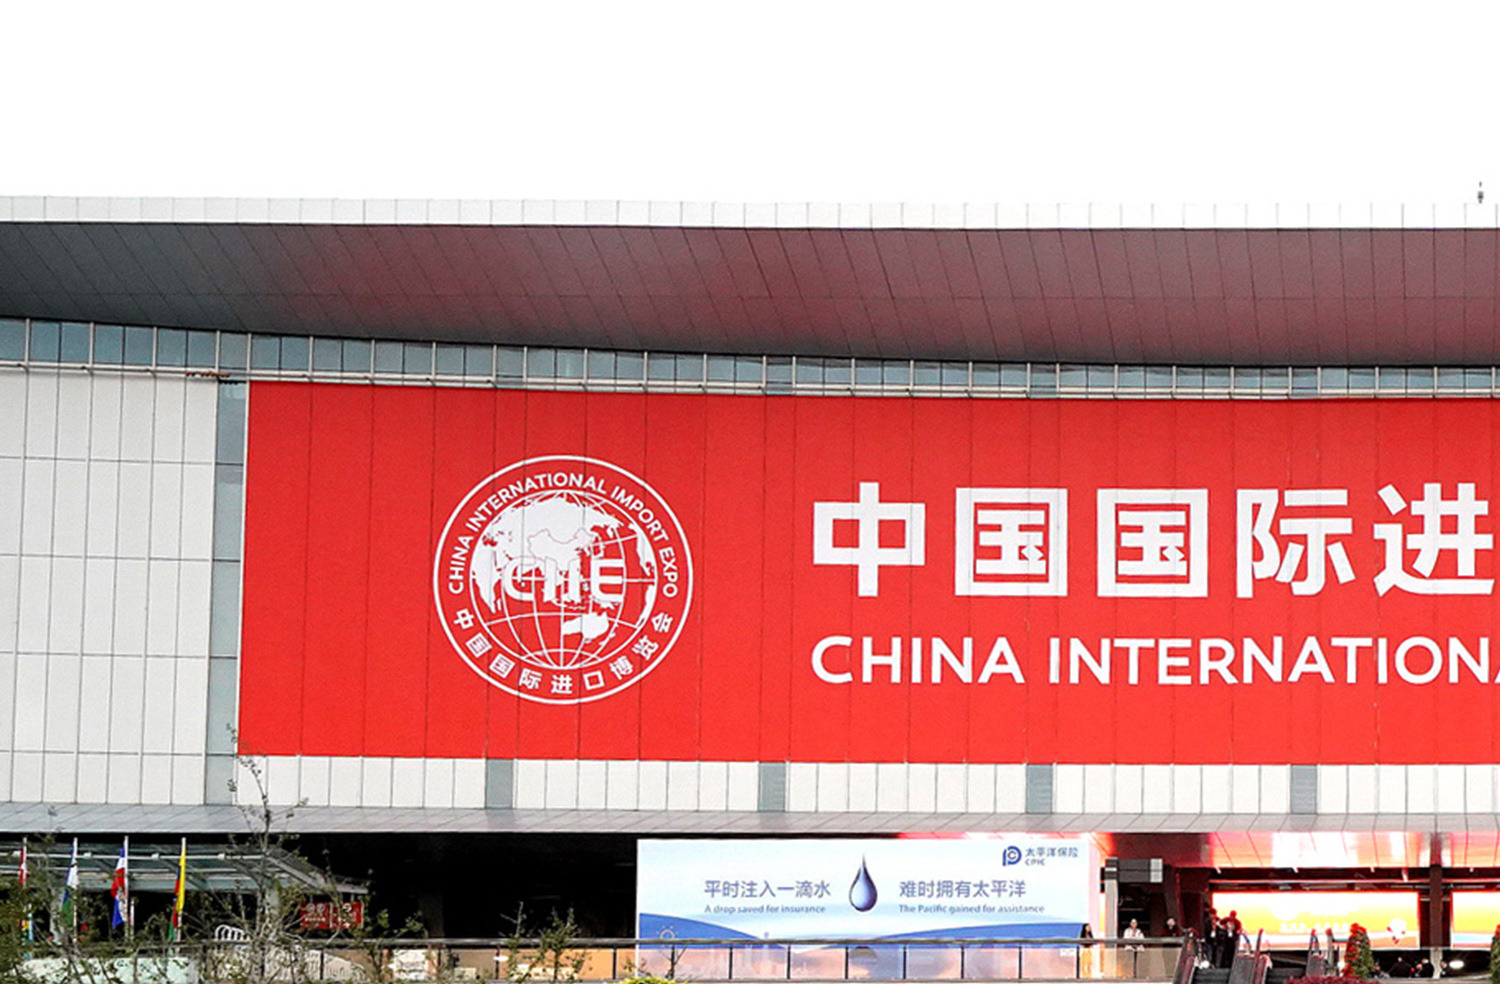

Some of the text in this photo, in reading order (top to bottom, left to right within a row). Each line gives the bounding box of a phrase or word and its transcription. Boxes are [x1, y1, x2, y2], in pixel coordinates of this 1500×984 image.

[449, 472, 678, 598] CHINA INTERNATIONAL IMPORT EXPO
[503, 556, 625, 603] CIIE
[453, 608, 673, 694] 中国国际进口博览会
[811, 635, 1025, 684] CHINA
[704, 880, 831, 898] 平时注入一滴水
[899, 880, 1026, 898] 难时拥有太平洋
[704, 904, 825, 915] A drop saved for insurance
[899, 904, 1044, 915] The Pacific gained for assistance
